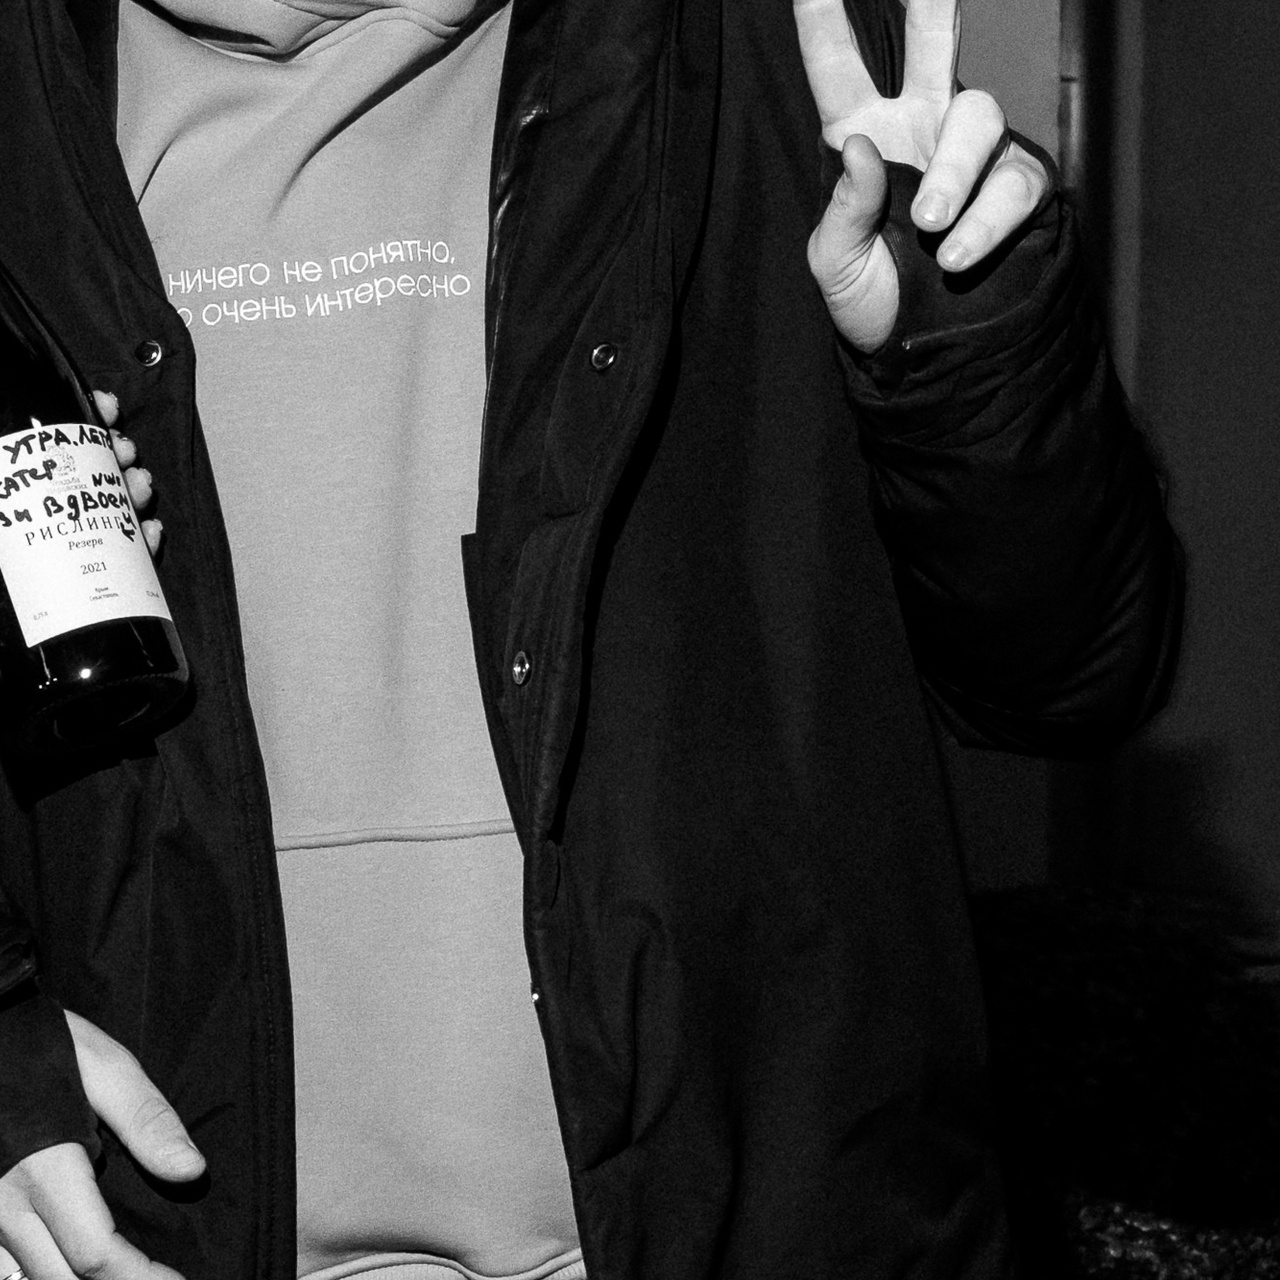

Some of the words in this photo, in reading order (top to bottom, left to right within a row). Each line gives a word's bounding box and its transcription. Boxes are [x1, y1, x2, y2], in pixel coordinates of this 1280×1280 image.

[168, 262, 270, 296] ничего
[283, 261, 322, 284] не
[331, 240, 455, 279] понятно,
[202, 296, 297, 326] очень
[305, 274, 471, 317] интересно
[68, 538, 104, 551] Резерв
[80, 561, 107, 575] 2021
